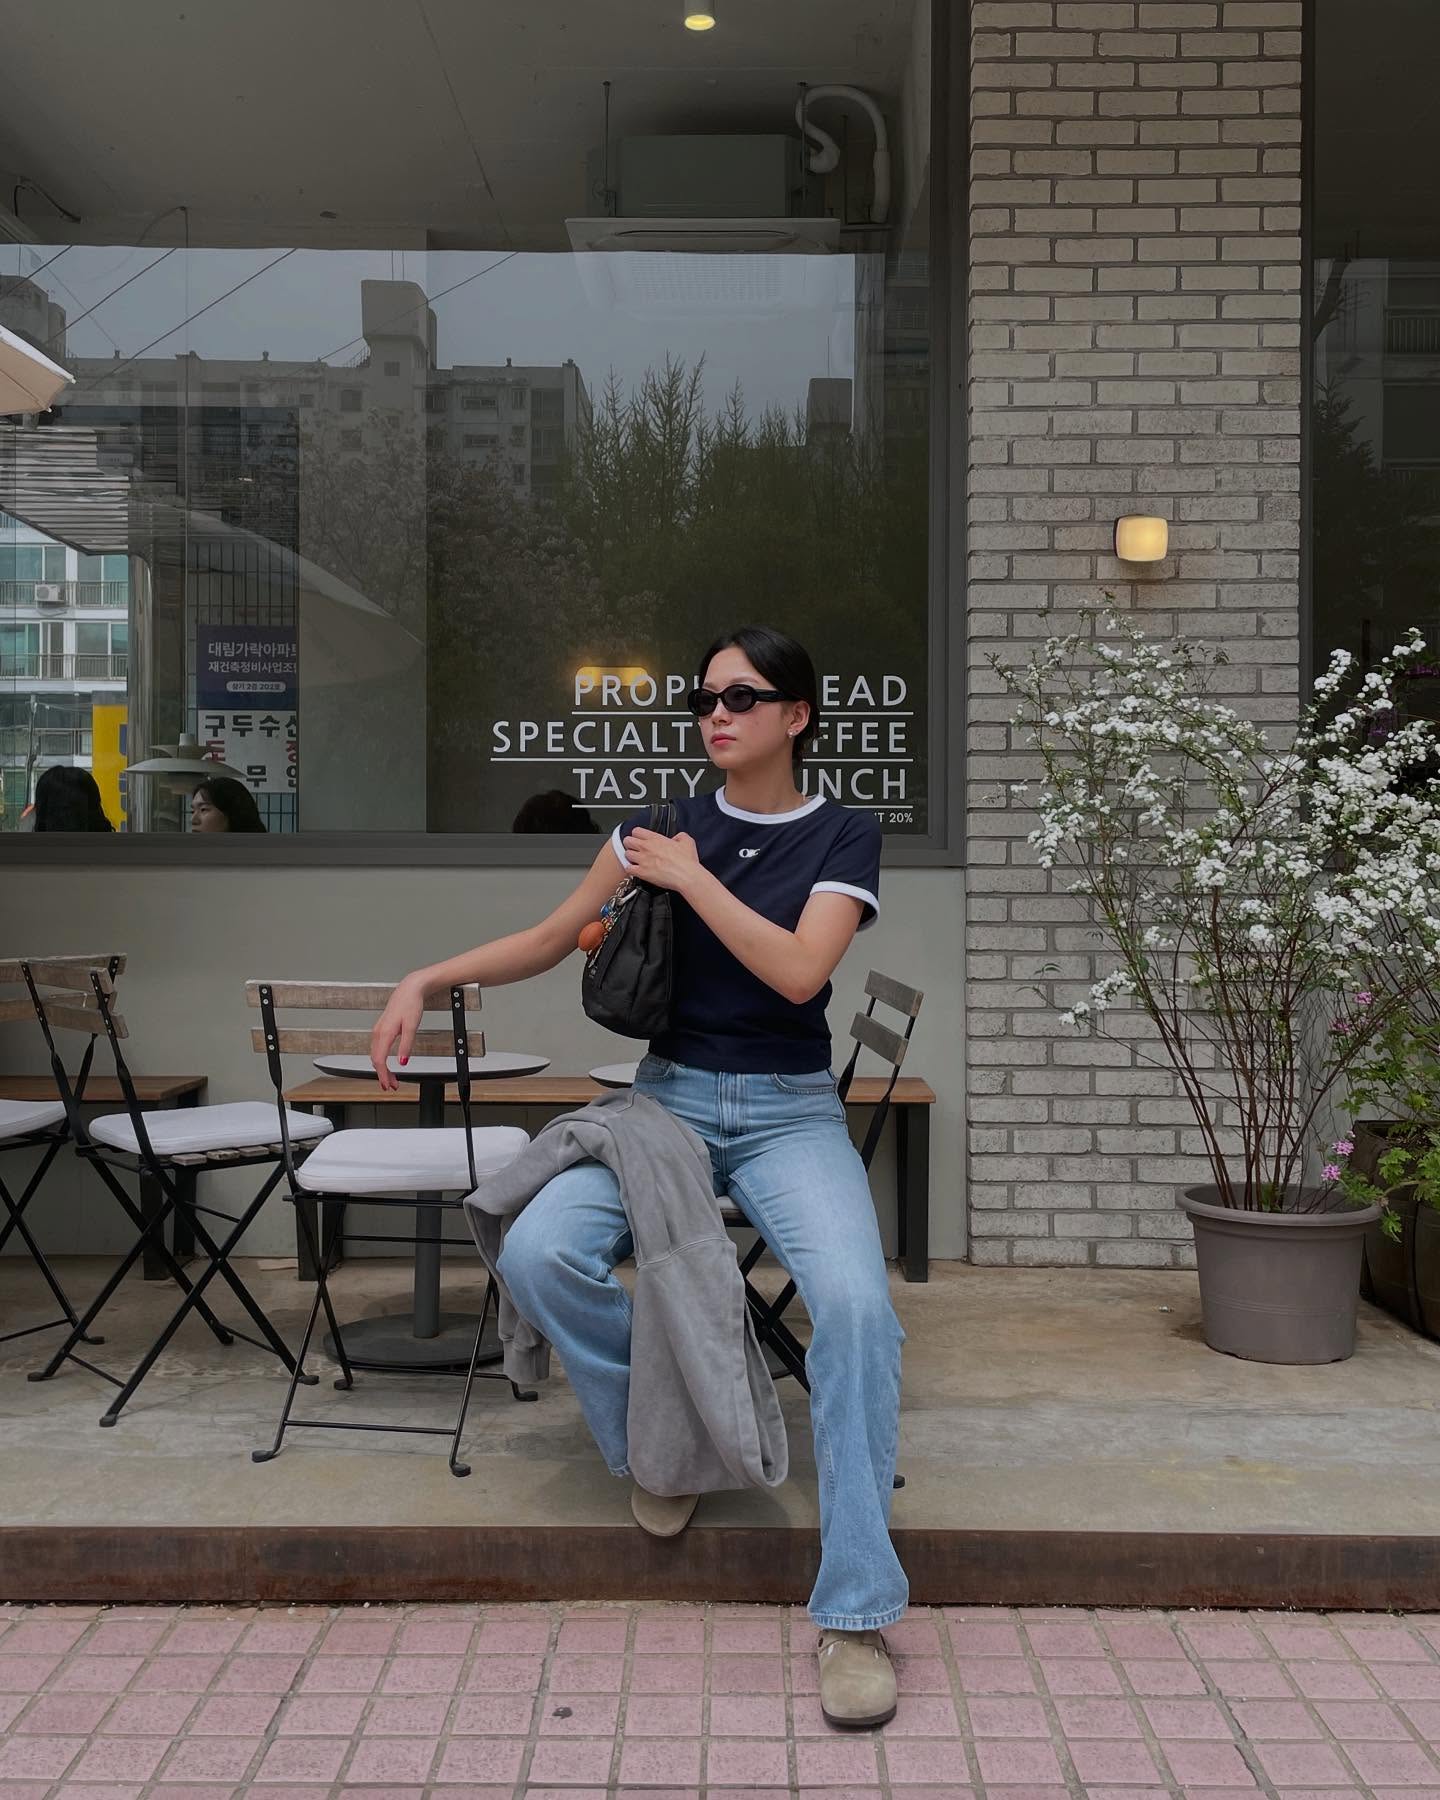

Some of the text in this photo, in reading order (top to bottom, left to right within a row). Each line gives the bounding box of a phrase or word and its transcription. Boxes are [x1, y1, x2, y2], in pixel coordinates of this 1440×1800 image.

[208, 661, 297, 674] 재건축정비사업조
[575, 675, 907, 706] PROP EAD
[492, 721, 693, 752] SPECIALT
[572, 768, 705, 799] TASTY
[889, 812, 913, 823] 20%
